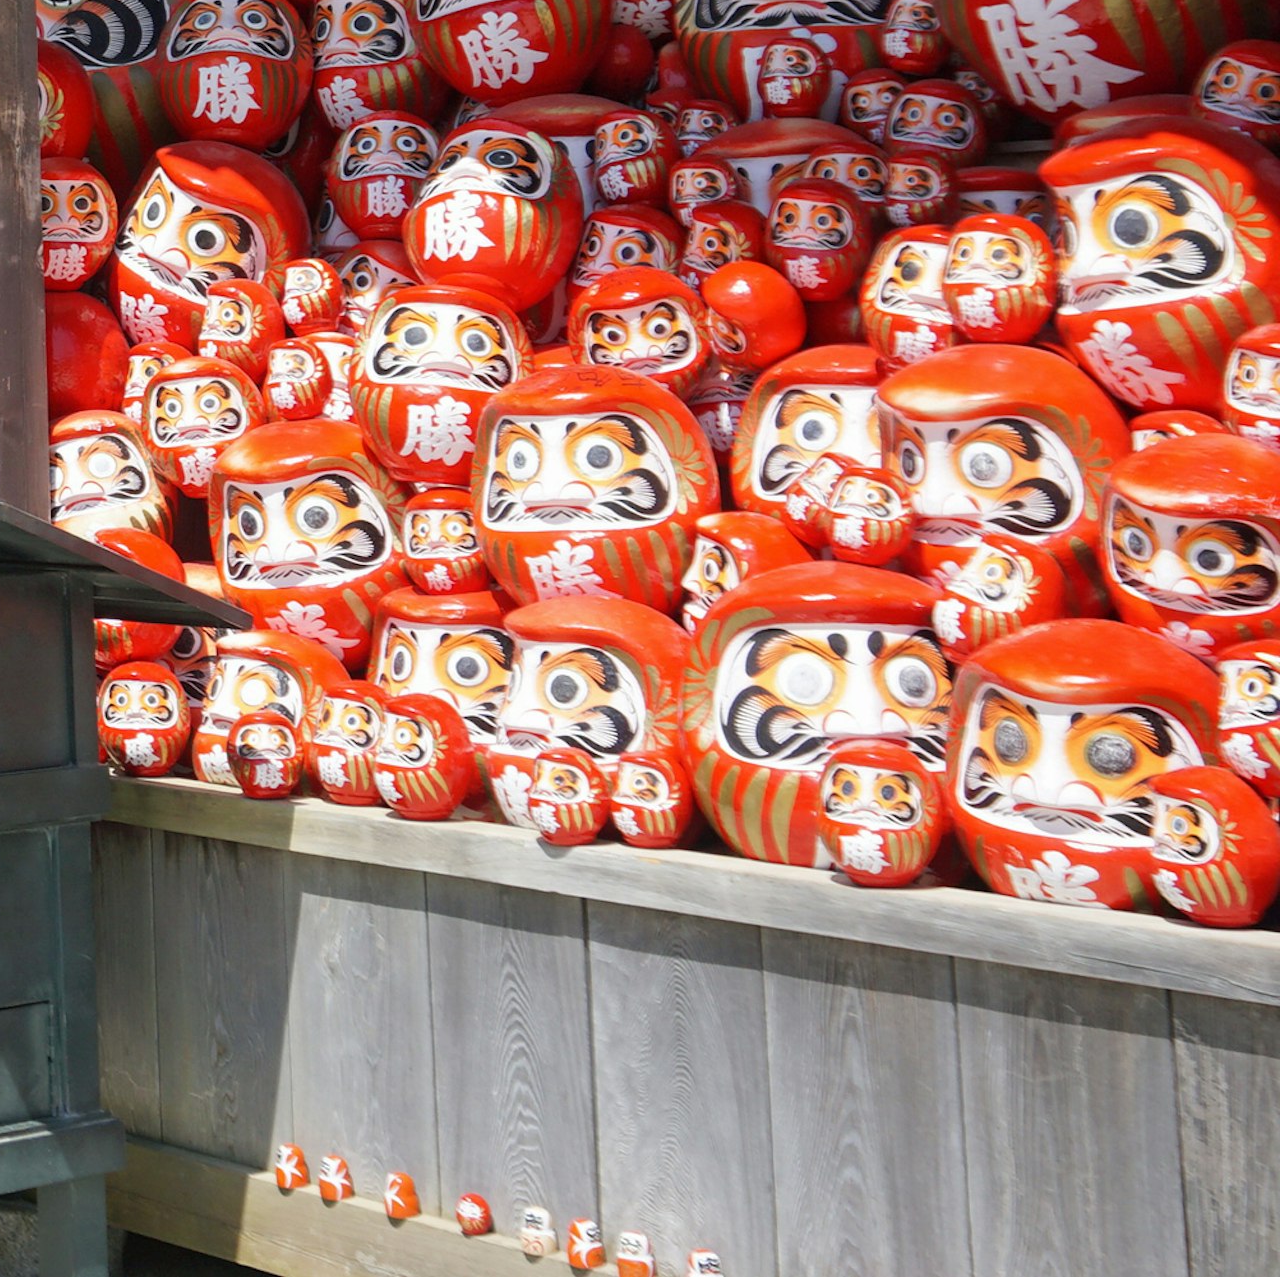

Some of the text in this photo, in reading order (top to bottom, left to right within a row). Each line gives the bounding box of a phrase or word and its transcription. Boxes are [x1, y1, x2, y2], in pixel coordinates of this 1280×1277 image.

[458, 11, 549, 89] 勝
[192, 55, 262, 123] 勝
[316, 76, 371, 130] 勝
[366, 176, 410, 218] 勝
[598, 165, 634, 201] 勝
[424, 189, 495, 261] 勝
[43, 244, 88, 283] 勝
[785, 256, 828, 289] 勝
[957, 288, 1002, 328] 勝
[1079, 320, 1186, 406] 勝
[401, 396, 474, 466] 勝
[424, 565, 454, 590] 勝
[124, 731, 160, 765] 勝
[253, 757, 285, 789] 勝
